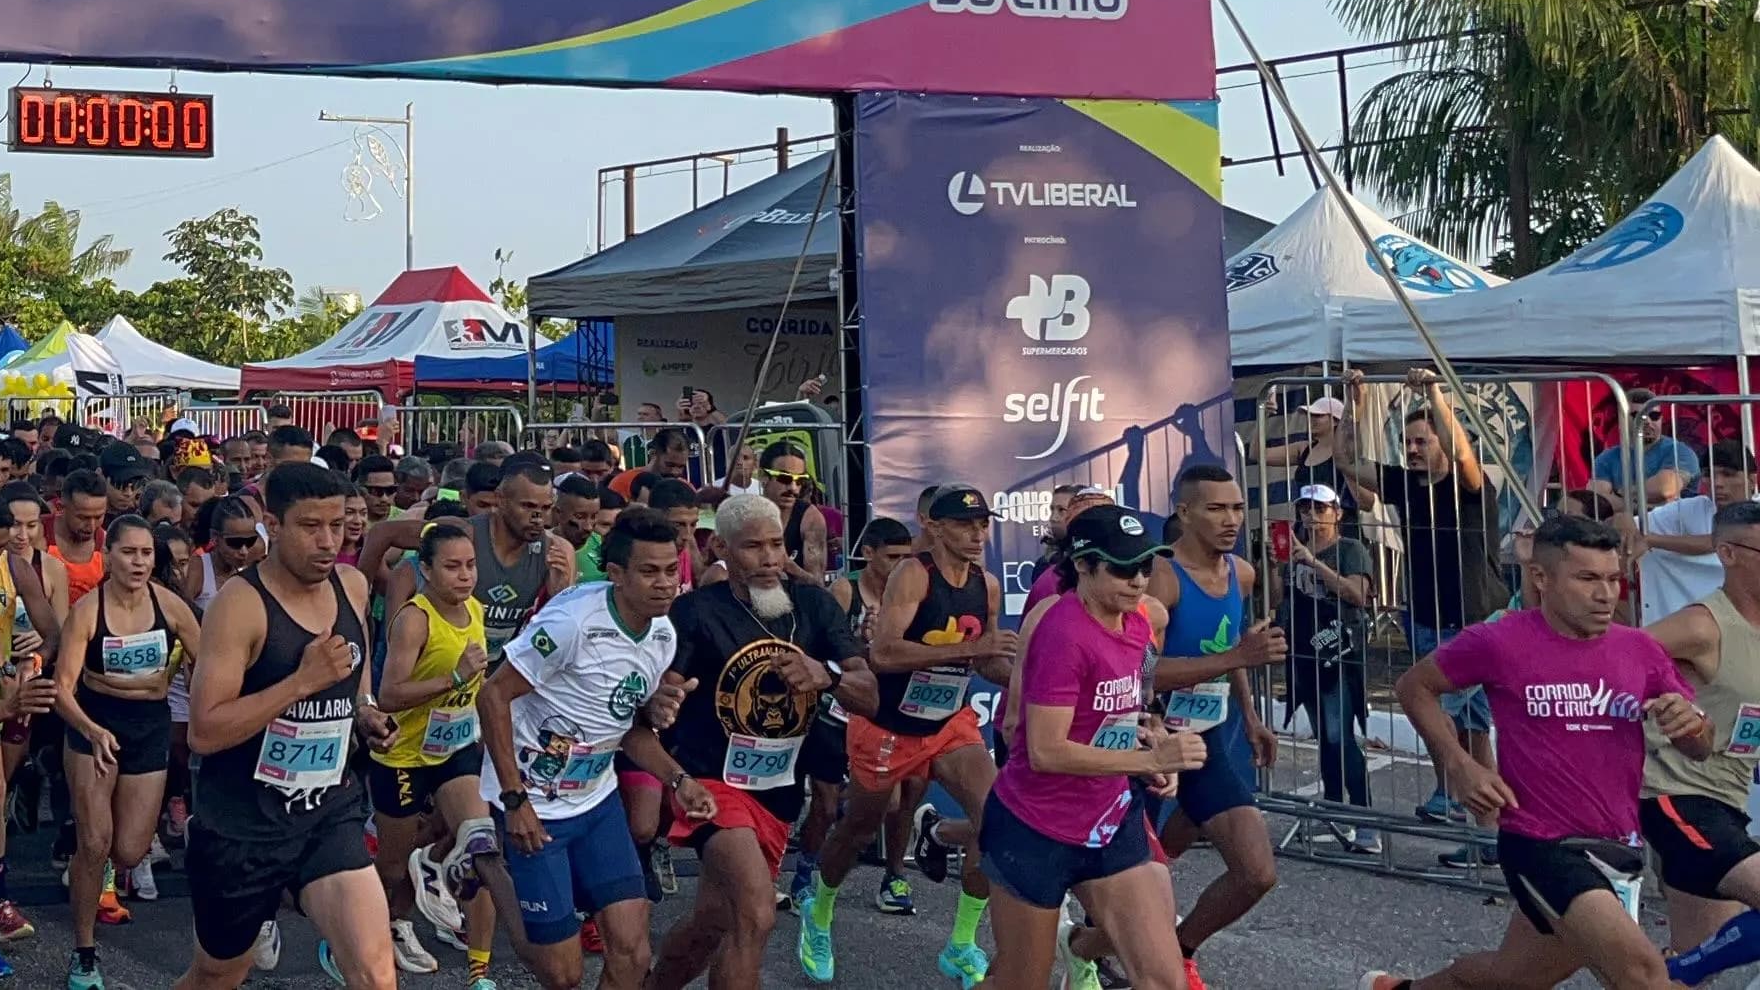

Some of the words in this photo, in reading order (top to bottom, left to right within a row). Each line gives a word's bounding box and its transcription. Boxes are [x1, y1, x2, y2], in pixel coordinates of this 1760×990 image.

[21, 95, 207, 149] 00:00:00
[746, 317, 833, 336] CORRIDA
[1003, 375, 1106, 460] selfit
[108, 647, 158, 666] 8658
[910, 685, 954, 704] 8029
[1525, 683, 1592, 701] CORRIDA
[1171, 696, 1220, 715] 7197
[1527, 701, 1550, 717] DO
[430, 721, 471, 741] 4610
[268, 741, 335, 765] 8714
[732, 751, 789, 772] 8790
